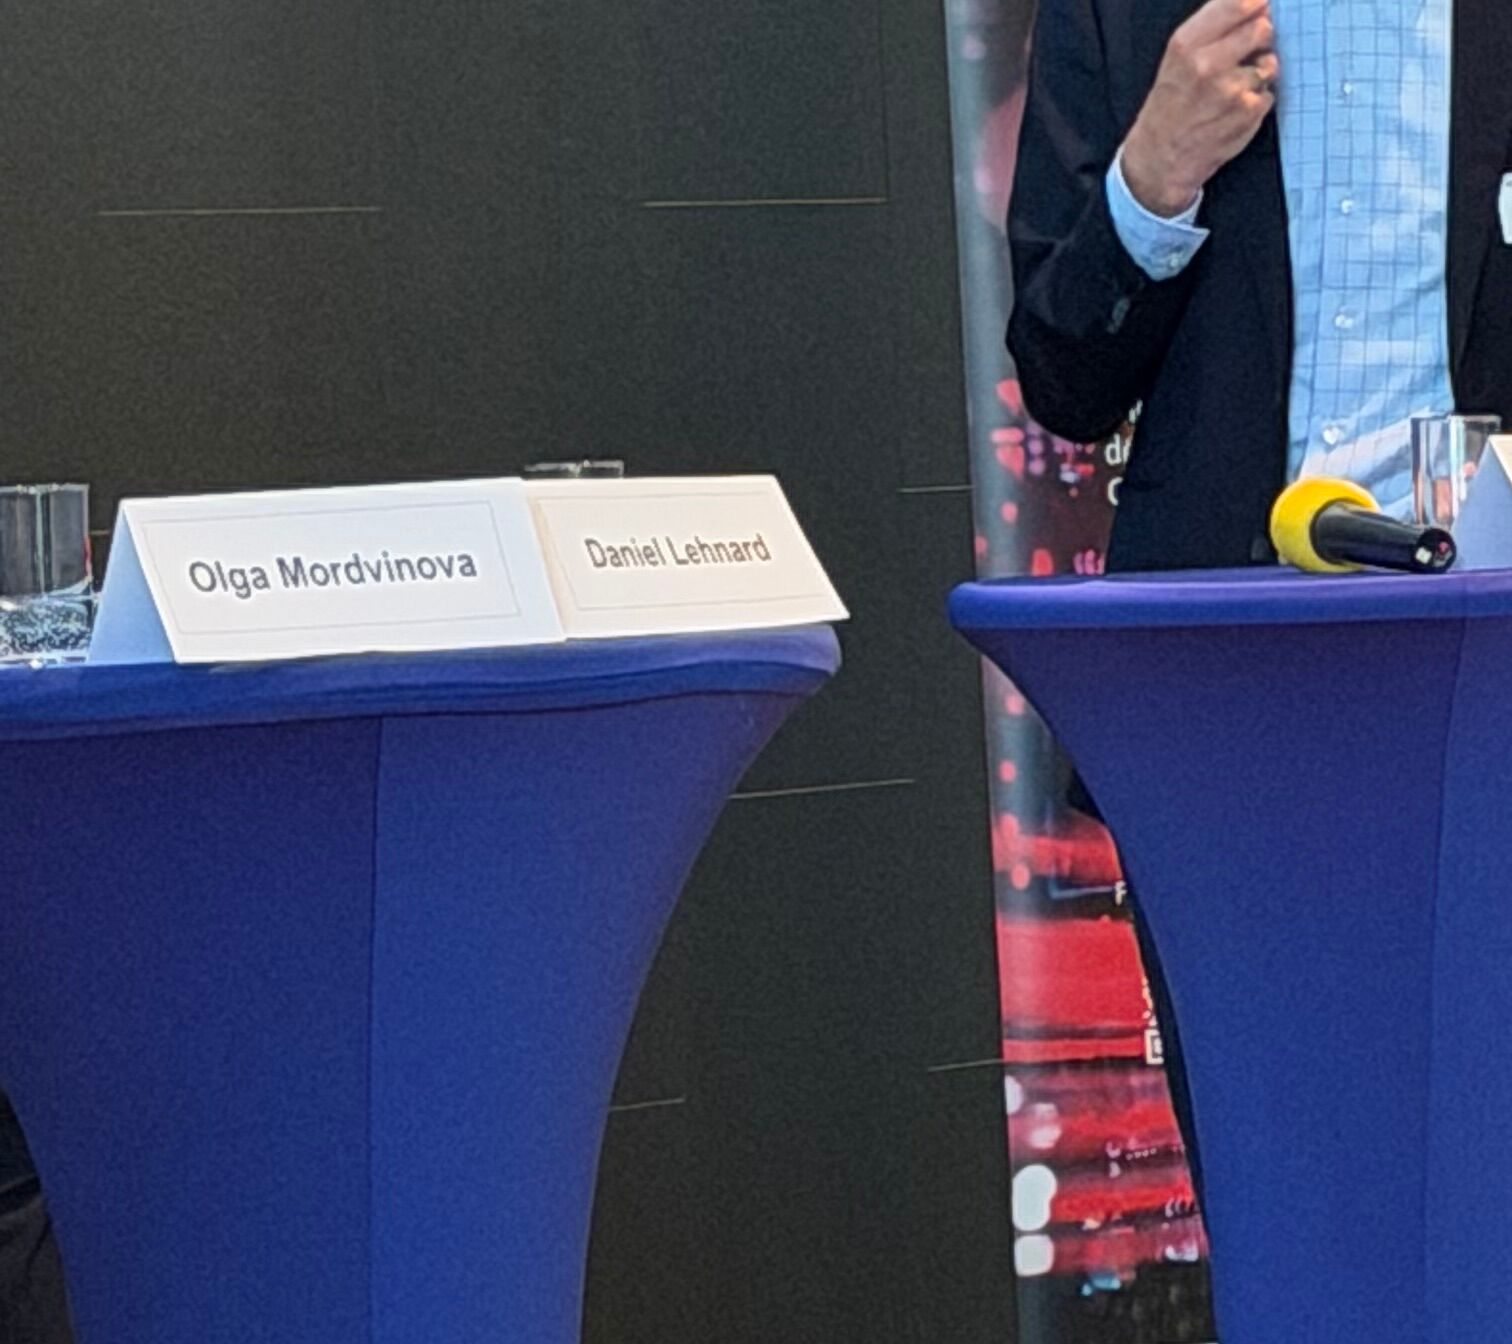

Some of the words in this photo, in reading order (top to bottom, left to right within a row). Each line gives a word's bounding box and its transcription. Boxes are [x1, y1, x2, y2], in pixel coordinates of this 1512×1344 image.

[584, 536, 666, 568] Daniel
[665, 532, 773, 566] Lehnard
[189, 559, 271, 600] Olga
[276, 549, 478, 588] Mordvinova
